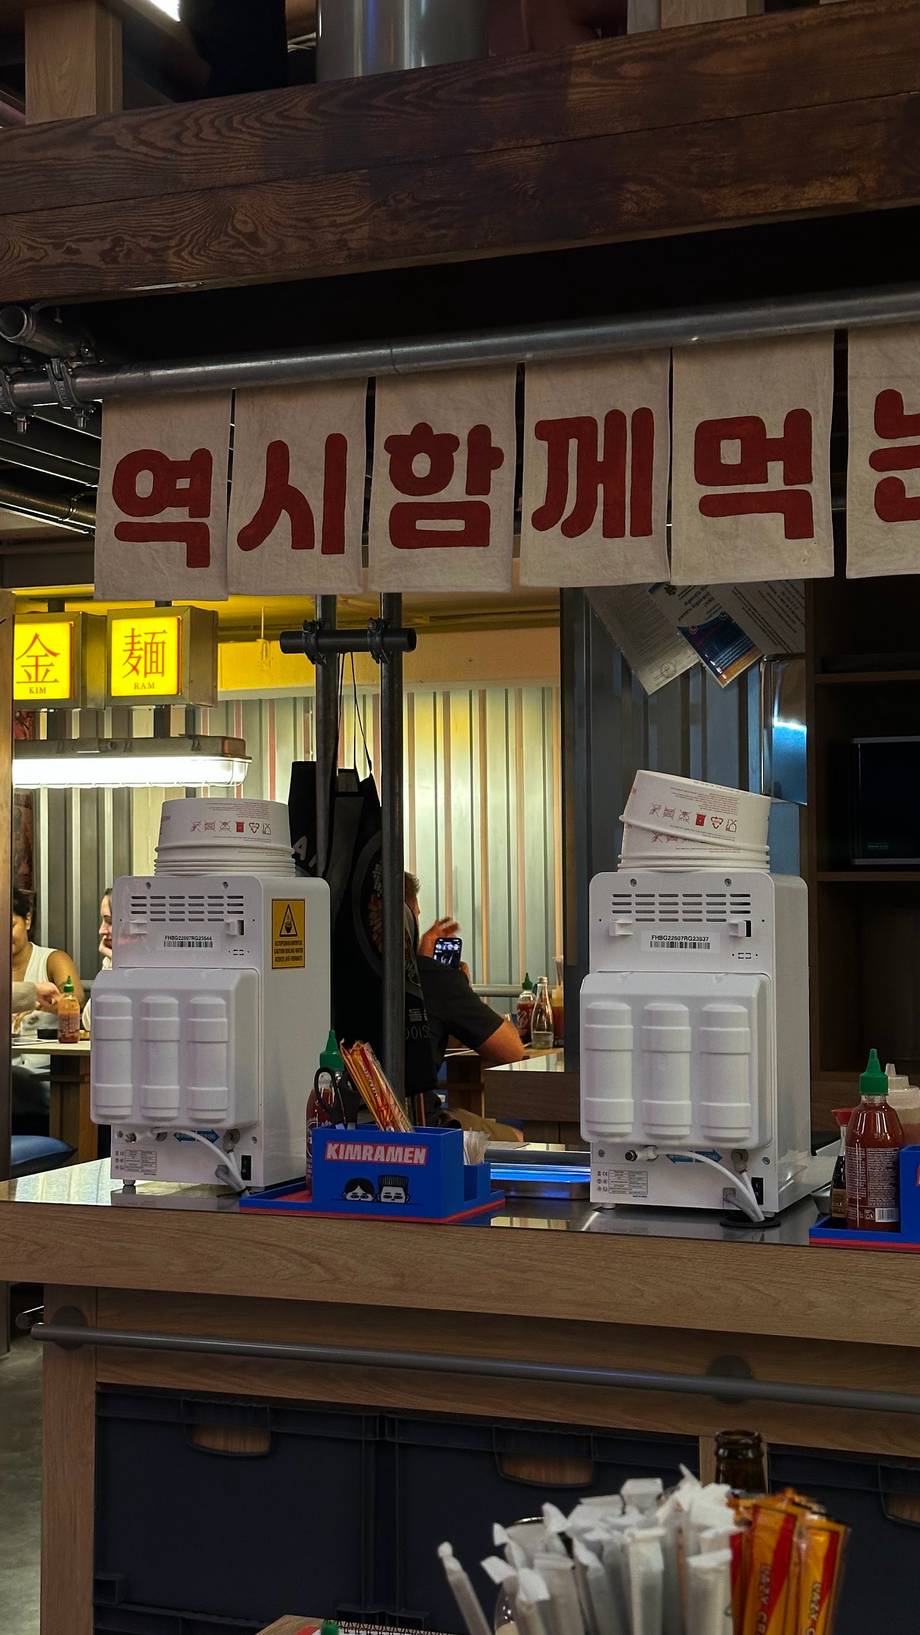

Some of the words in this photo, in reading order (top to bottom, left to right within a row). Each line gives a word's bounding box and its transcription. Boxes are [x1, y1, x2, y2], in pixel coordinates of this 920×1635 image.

[16, 632, 60, 684] 金
[29, 686, 47, 694] KIM
[133, 682, 155, 690] RAM
[325, 1142, 427, 1164] KIMRAMEN
